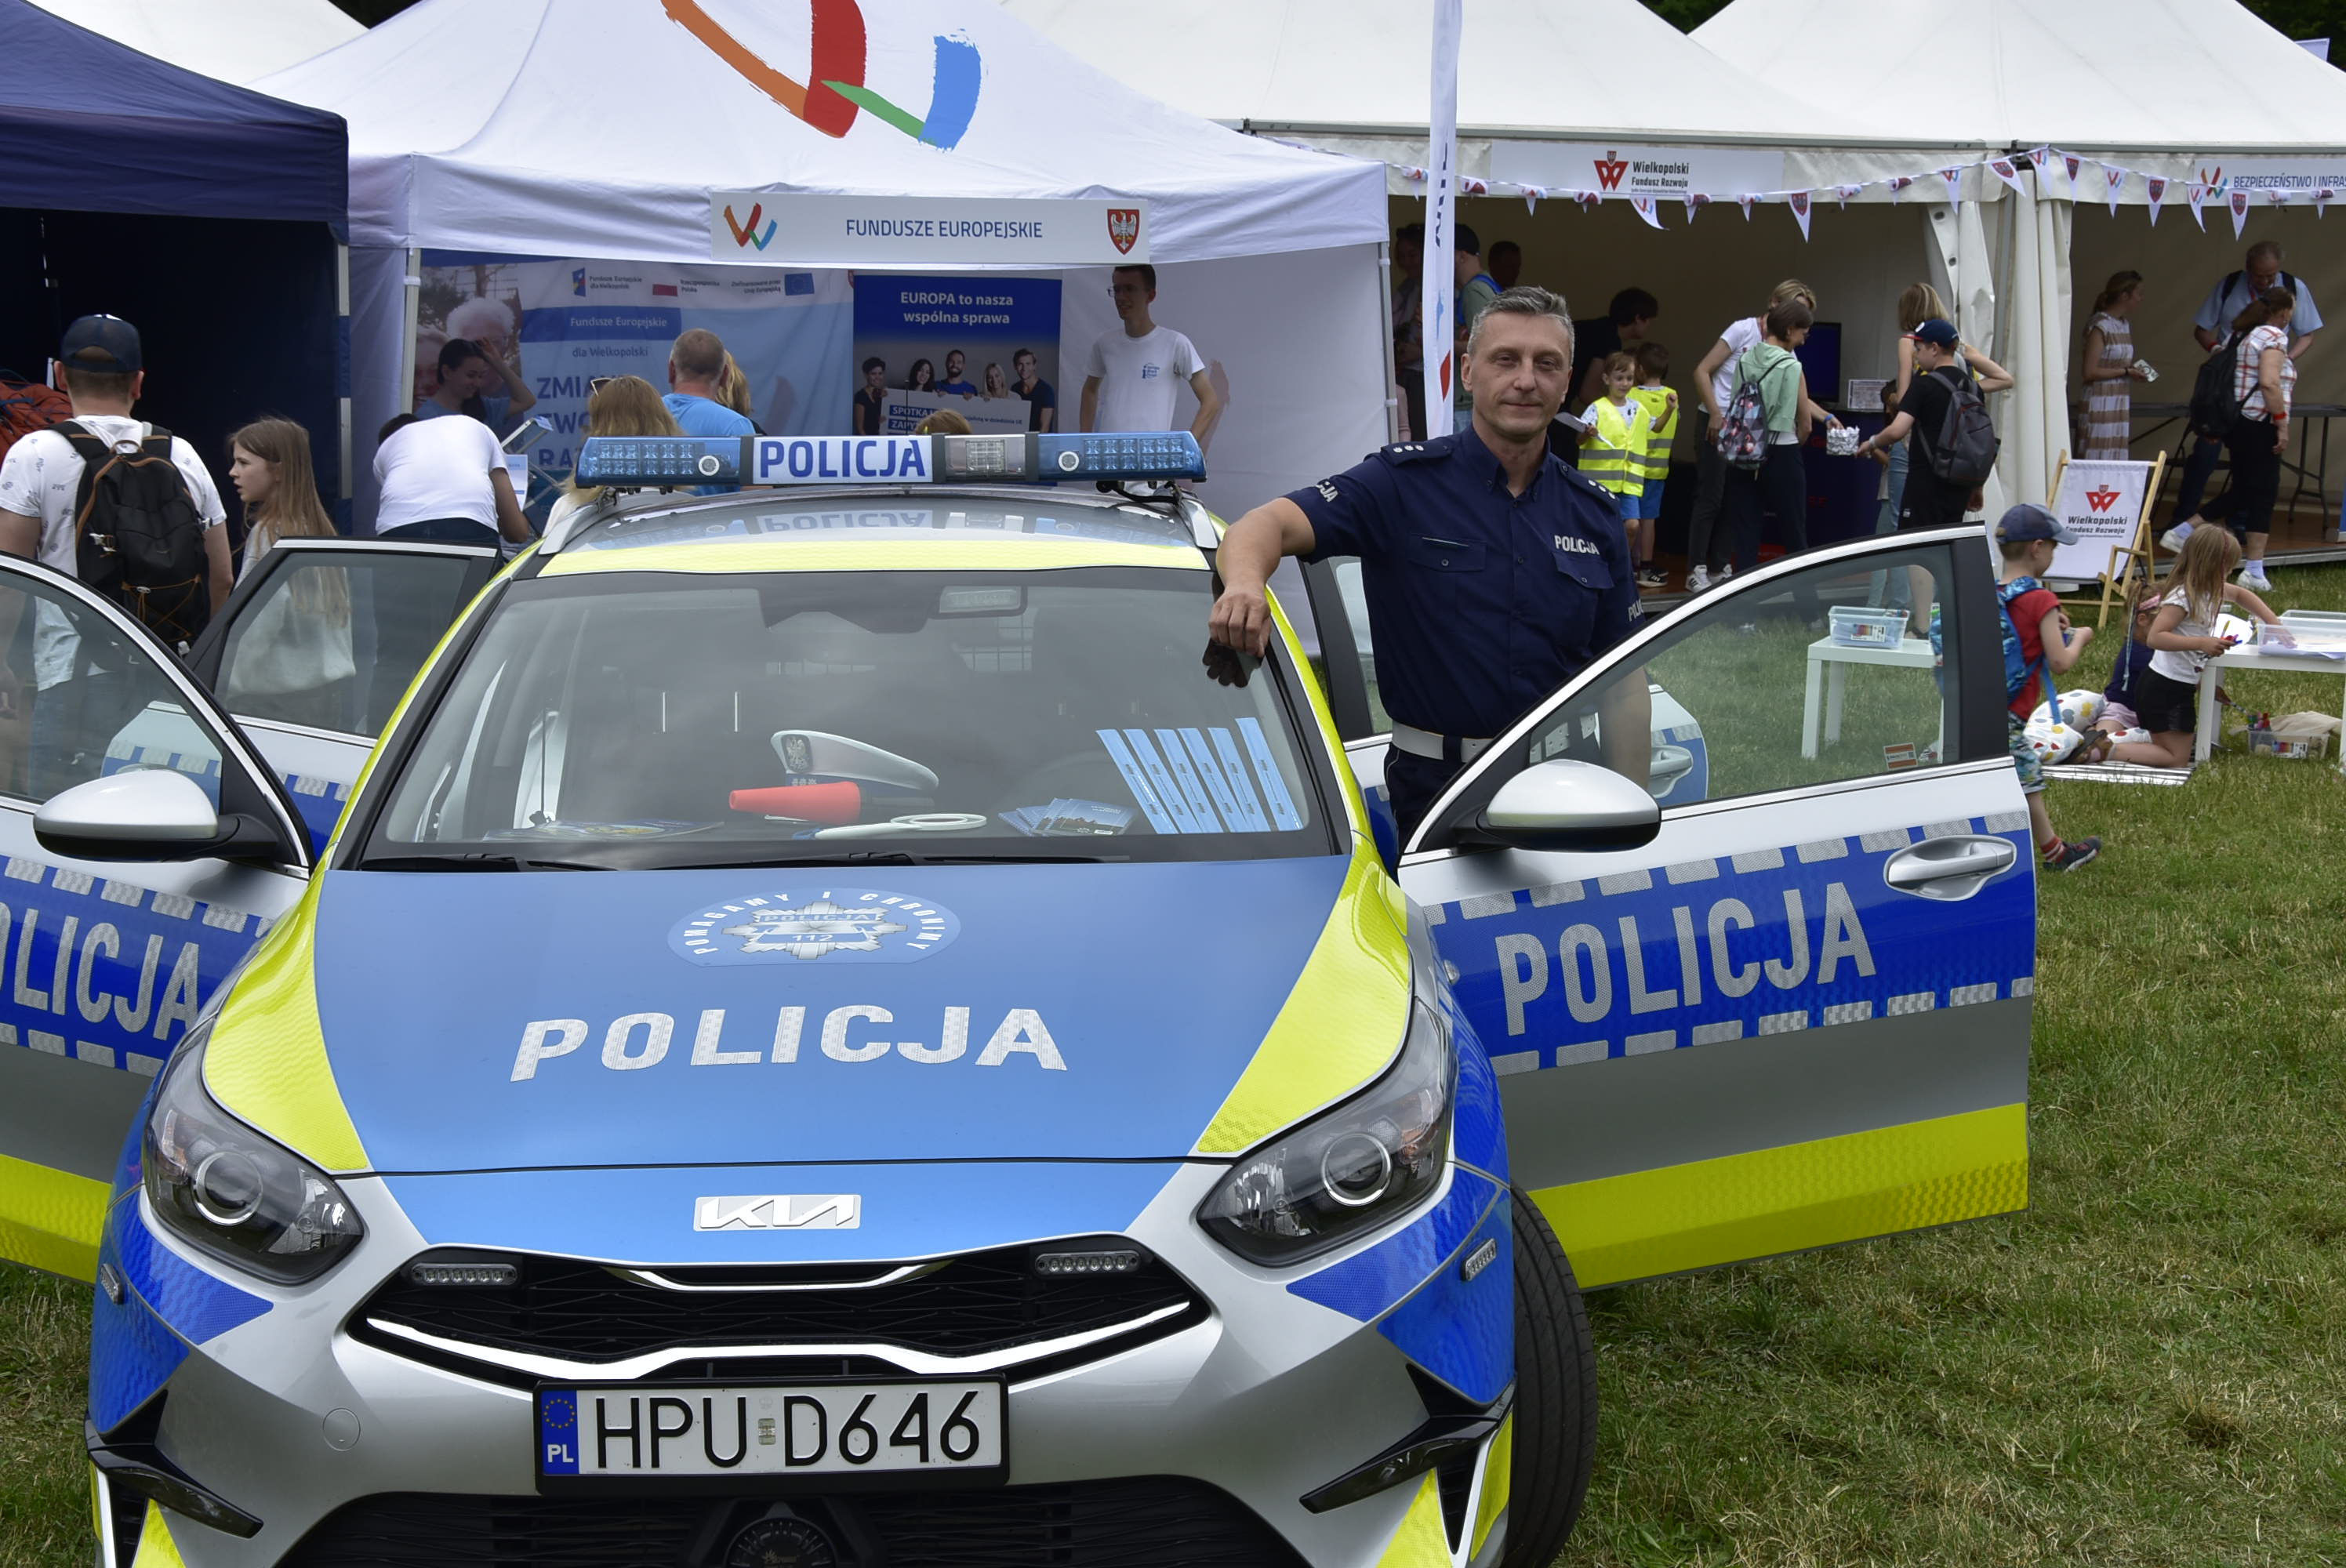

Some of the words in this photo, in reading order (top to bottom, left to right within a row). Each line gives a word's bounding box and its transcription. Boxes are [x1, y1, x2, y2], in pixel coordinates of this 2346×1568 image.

[1632, 161, 1690, 176] Wielkopolski
[1631, 177, 1659, 187] Fundusz
[1661, 178, 1688, 189] Rozwoju
[2234, 172, 2312, 188] BEZPIECZEŃSTWO
[2319, 176, 2346, 187] INFRA
[846, 219, 934, 238] FUNDUSZE
[939, 220, 1043, 239] EUROPEJSKIE
[900, 292, 956, 304] EUROPA
[958, 294, 973, 305] to
[975, 296, 1014, 306] nasza
[570, 316, 613, 327] Fundusze
[616, 316, 668, 329] Europejskie
[903, 310, 960, 325] wspólna
[962, 313, 1010, 326] sprawa
[572, 346, 587, 358] dla
[589, 346, 648, 358] Wielkopolski
[760, 439, 926, 478] POLICJA
[2068, 516, 2128, 526] Wielkopolski
[1554, 535, 1600, 555] POLICJA
[684, 893, 789, 955] POMAGAMY
[859, 892, 946, 950] CHRONIMY
[763, 914, 871, 923] POLICJA
[792, 934, 833, 942] 112
[1495, 881, 1876, 1036] POLICJA
[510, 1004, 1068, 1083] POLICJA
[596, 1396, 747, 1468] HPU
[783, 1390, 979, 1467] D646
[547, 1444, 574, 1464] PL
